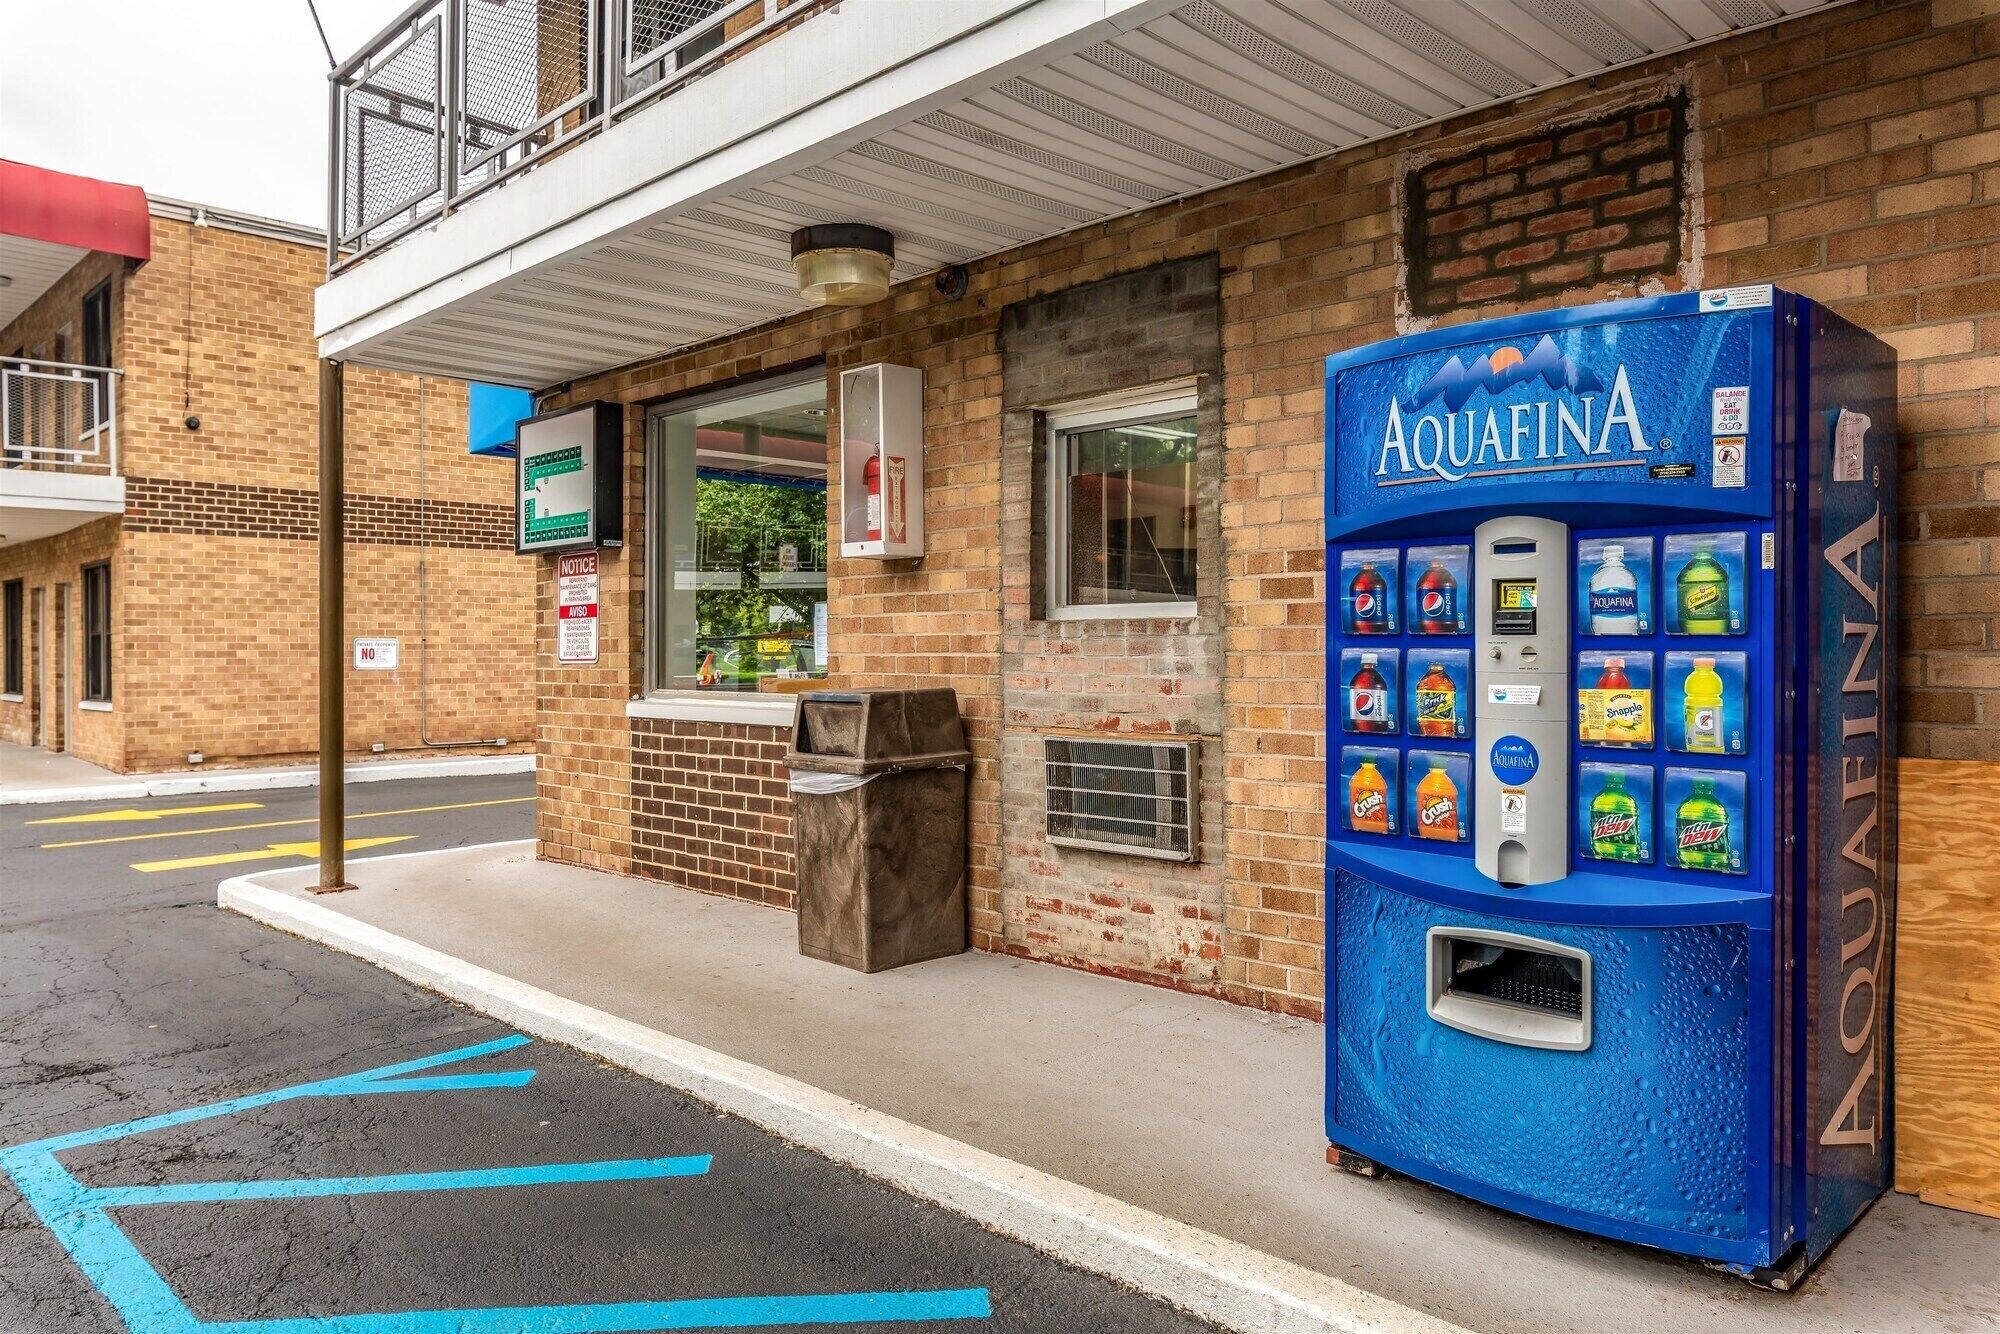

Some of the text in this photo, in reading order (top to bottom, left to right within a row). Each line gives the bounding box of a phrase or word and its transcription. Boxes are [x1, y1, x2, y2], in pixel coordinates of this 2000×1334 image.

[1374, 363, 1654, 482] AQUAFINA
[890, 466, 904, 475] FIRE
[562, 557, 595, 575] NOTICE
[1593, 596, 1635, 609] AQUAFINA
[1690, 591, 1715, 606] Schweppes
[569, 605, 587, 617] AVISO
[361, 648, 375, 660] NO
[1606, 703, 1643, 718] Snapple
[1493, 750, 1535, 768] AQUAFINA
[1353, 791, 1383, 818] Crush
[1421, 797, 1453, 825] Crush
[1820, 500, 1884, 1156] AQUAFINA
